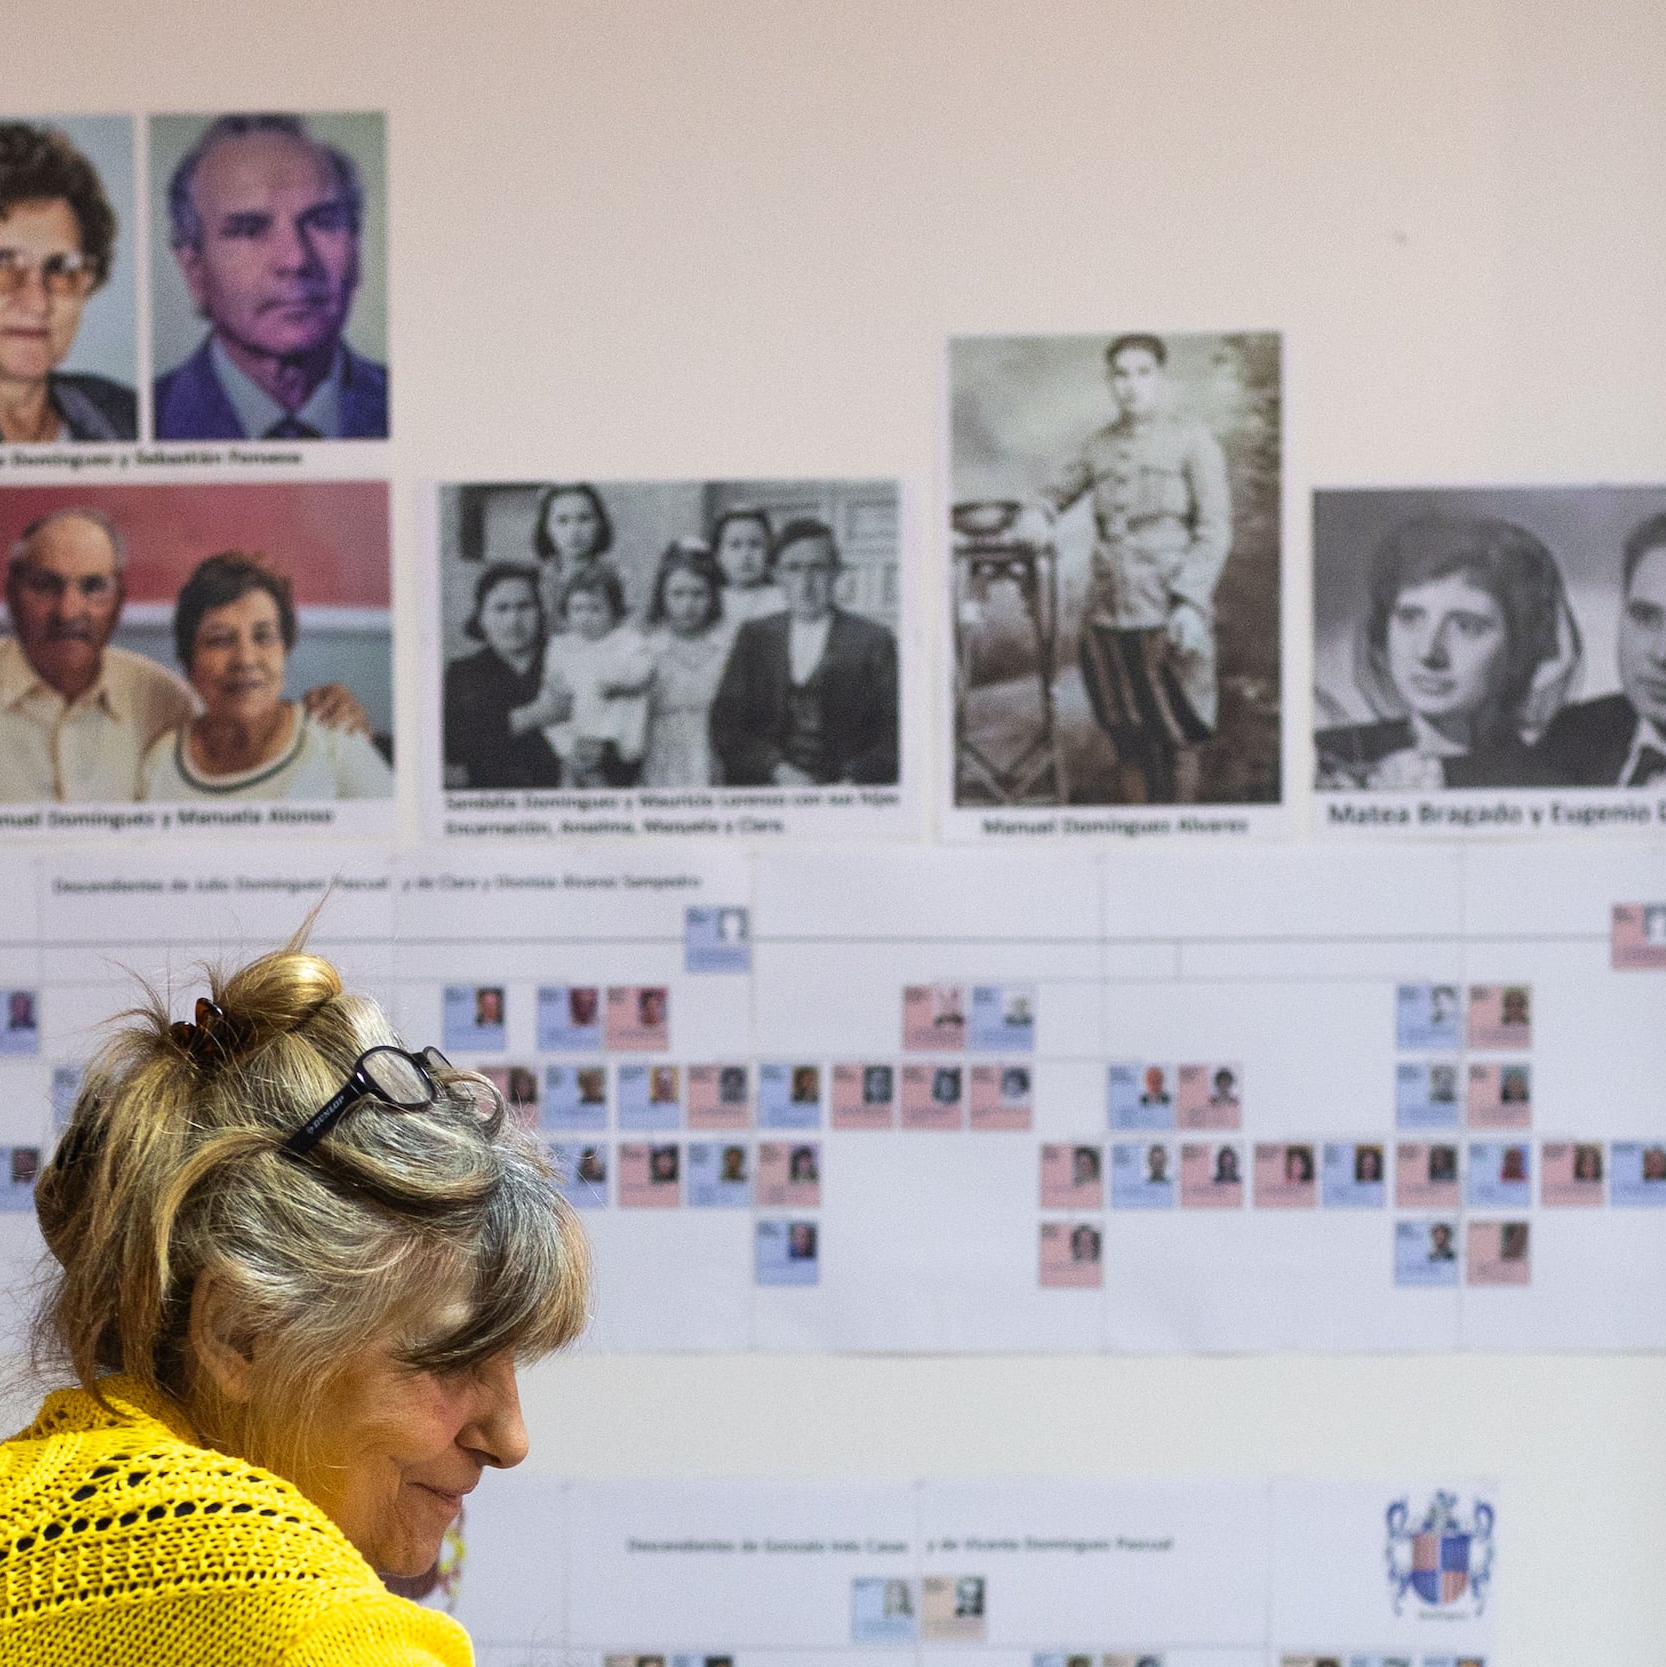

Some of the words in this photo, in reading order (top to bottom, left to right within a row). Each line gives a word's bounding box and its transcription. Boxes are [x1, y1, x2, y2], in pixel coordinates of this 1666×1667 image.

[161, 813, 171, 832] y
[176, 808, 262, 826] Manuela
[1327, 801, 1411, 825] Matea
[1418, 800, 1524, 830] Bragado
[1530, 806, 1542, 830] y
[1549, 800, 1653, 830] Eugenio
[643, 817, 719, 837] Manuela
[981, 817, 1056, 836] Manuel
[52, 876, 165, 895] Descendientes
[170, 878, 189, 893] de
